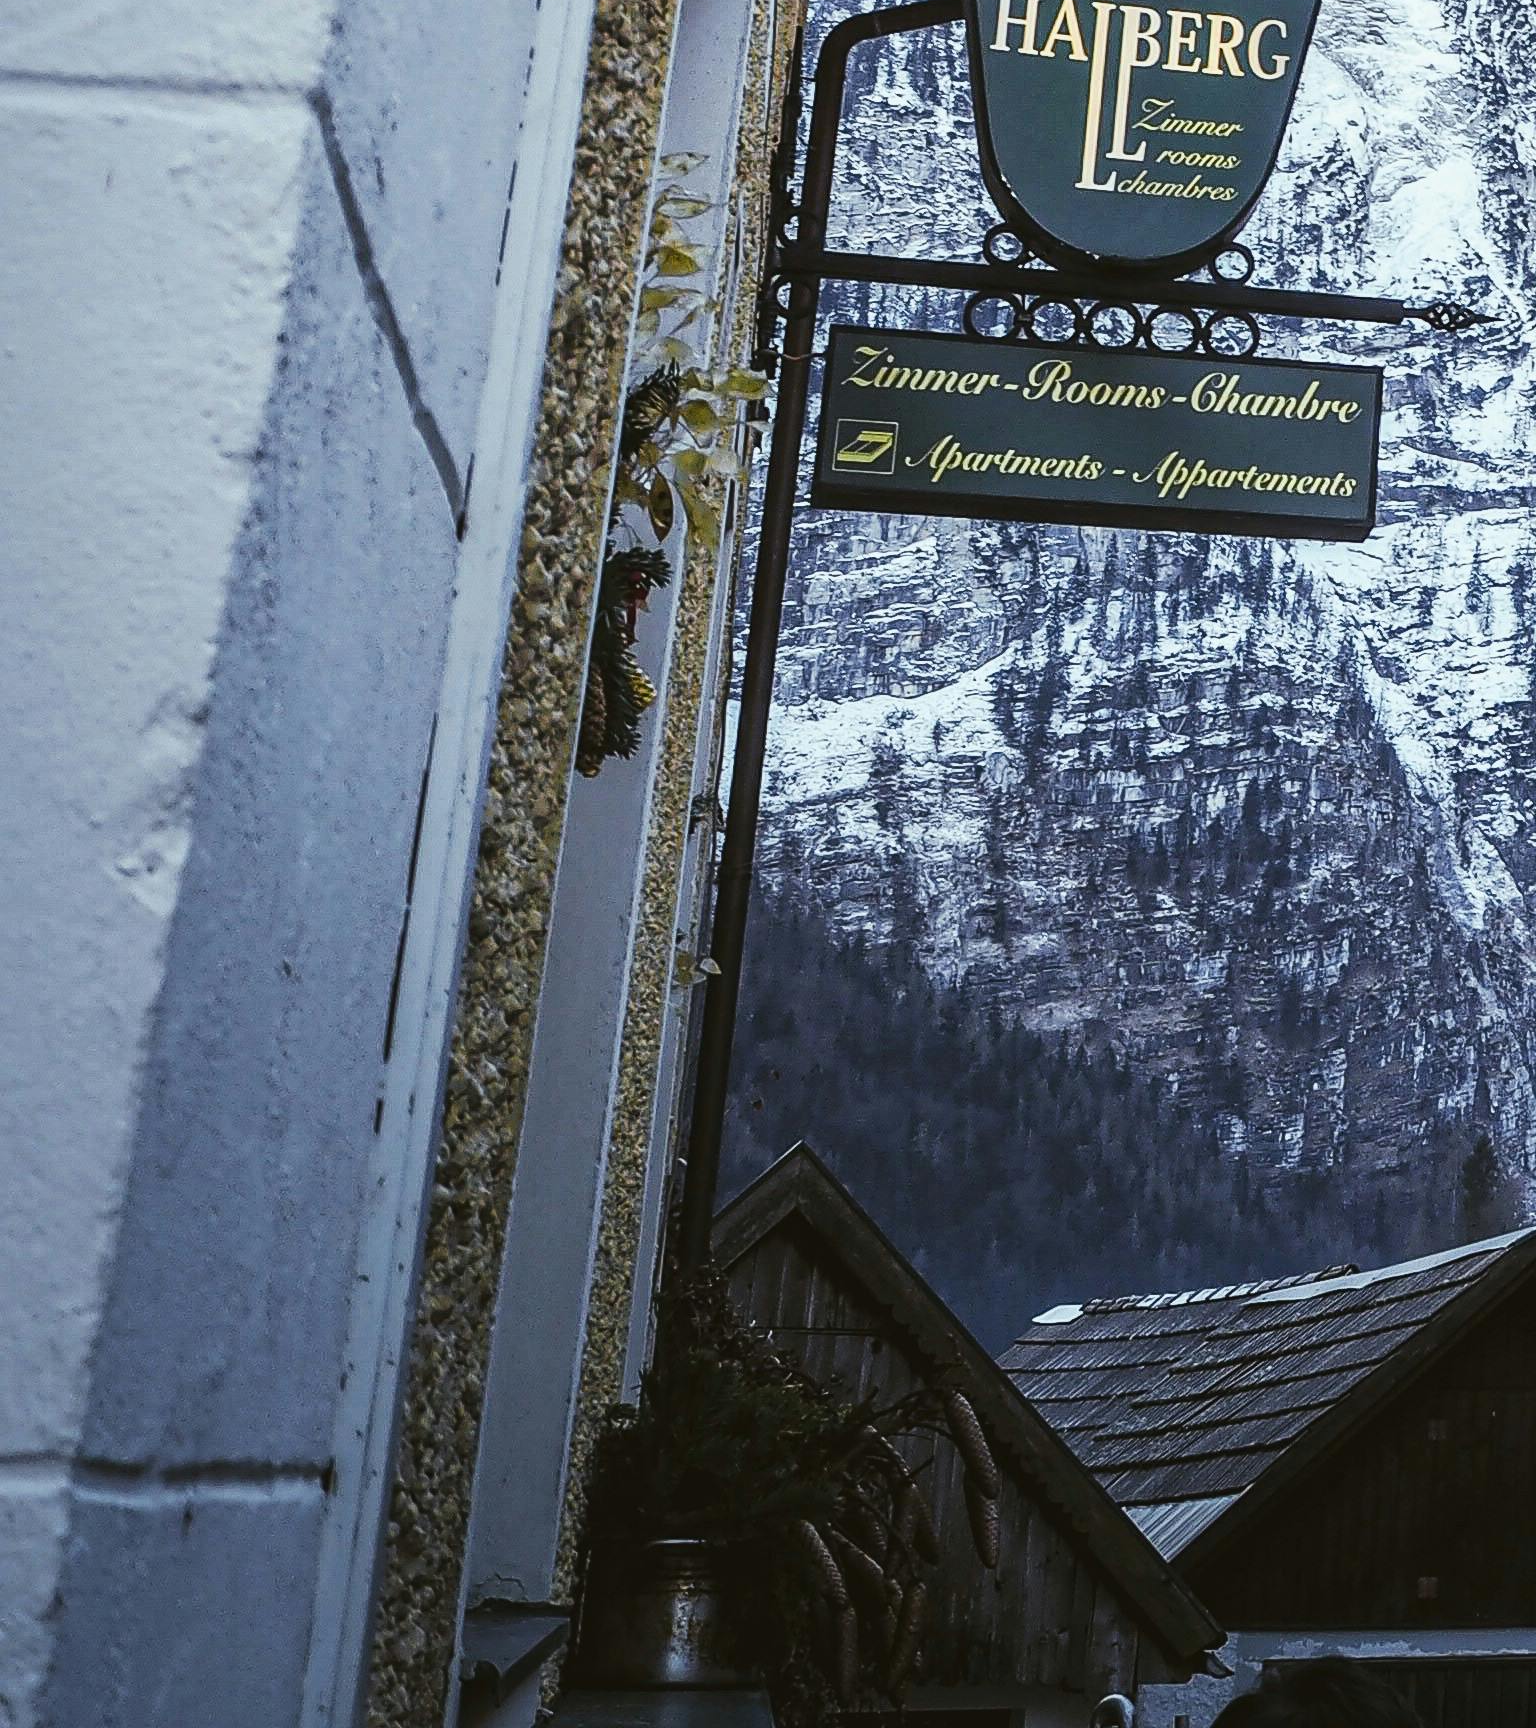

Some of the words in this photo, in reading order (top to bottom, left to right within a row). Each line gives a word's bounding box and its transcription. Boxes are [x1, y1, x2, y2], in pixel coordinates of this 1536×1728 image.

[1131, 98, 1244, 138] Zimmer
[1156, 146, 1241, 170] rooms
[1116, 176, 1239, 202] chambres
[904, 435, 1105, 483] Apartments
[1133, 451, 1357, 500] Appartements
